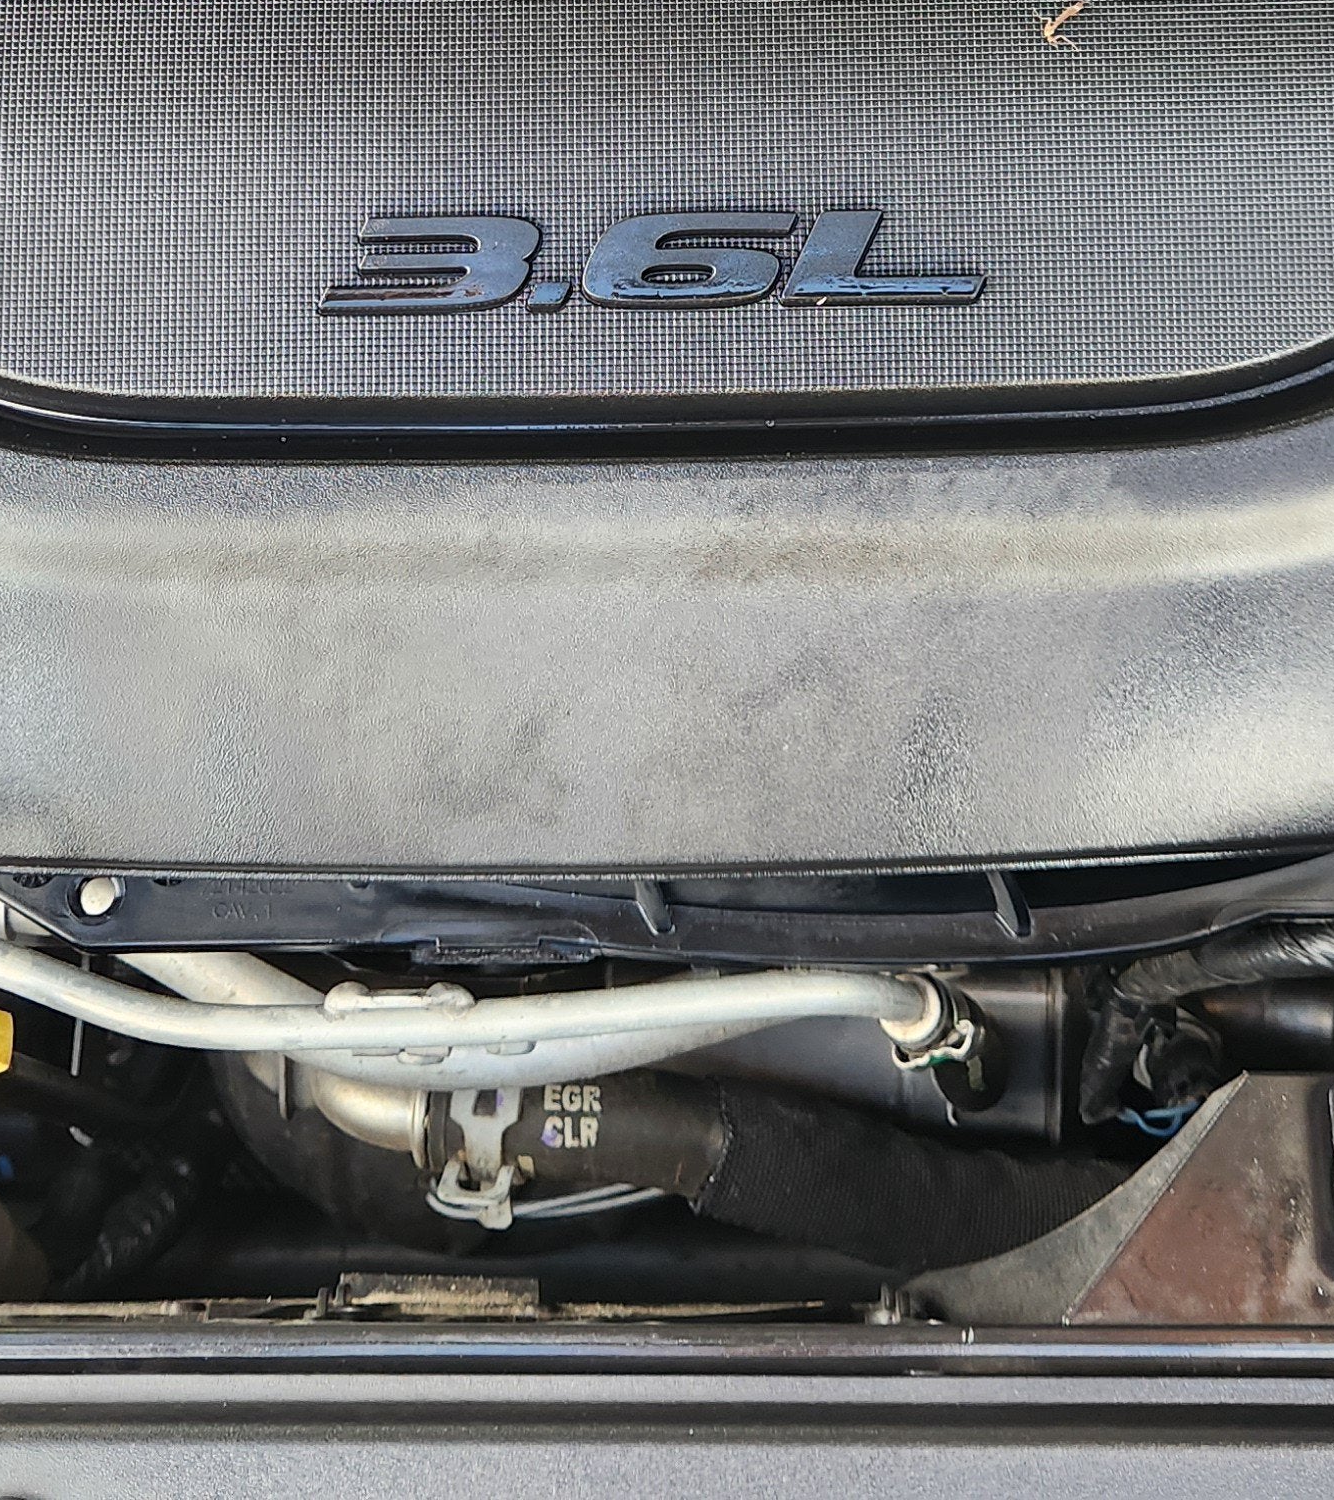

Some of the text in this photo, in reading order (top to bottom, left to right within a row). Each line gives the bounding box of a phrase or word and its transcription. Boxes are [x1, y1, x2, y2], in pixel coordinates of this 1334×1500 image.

[318, 208, 989, 317] 3.6L
[544, 1084, 603, 1112] EGR
[541, 1115, 599, 1149] CLR
